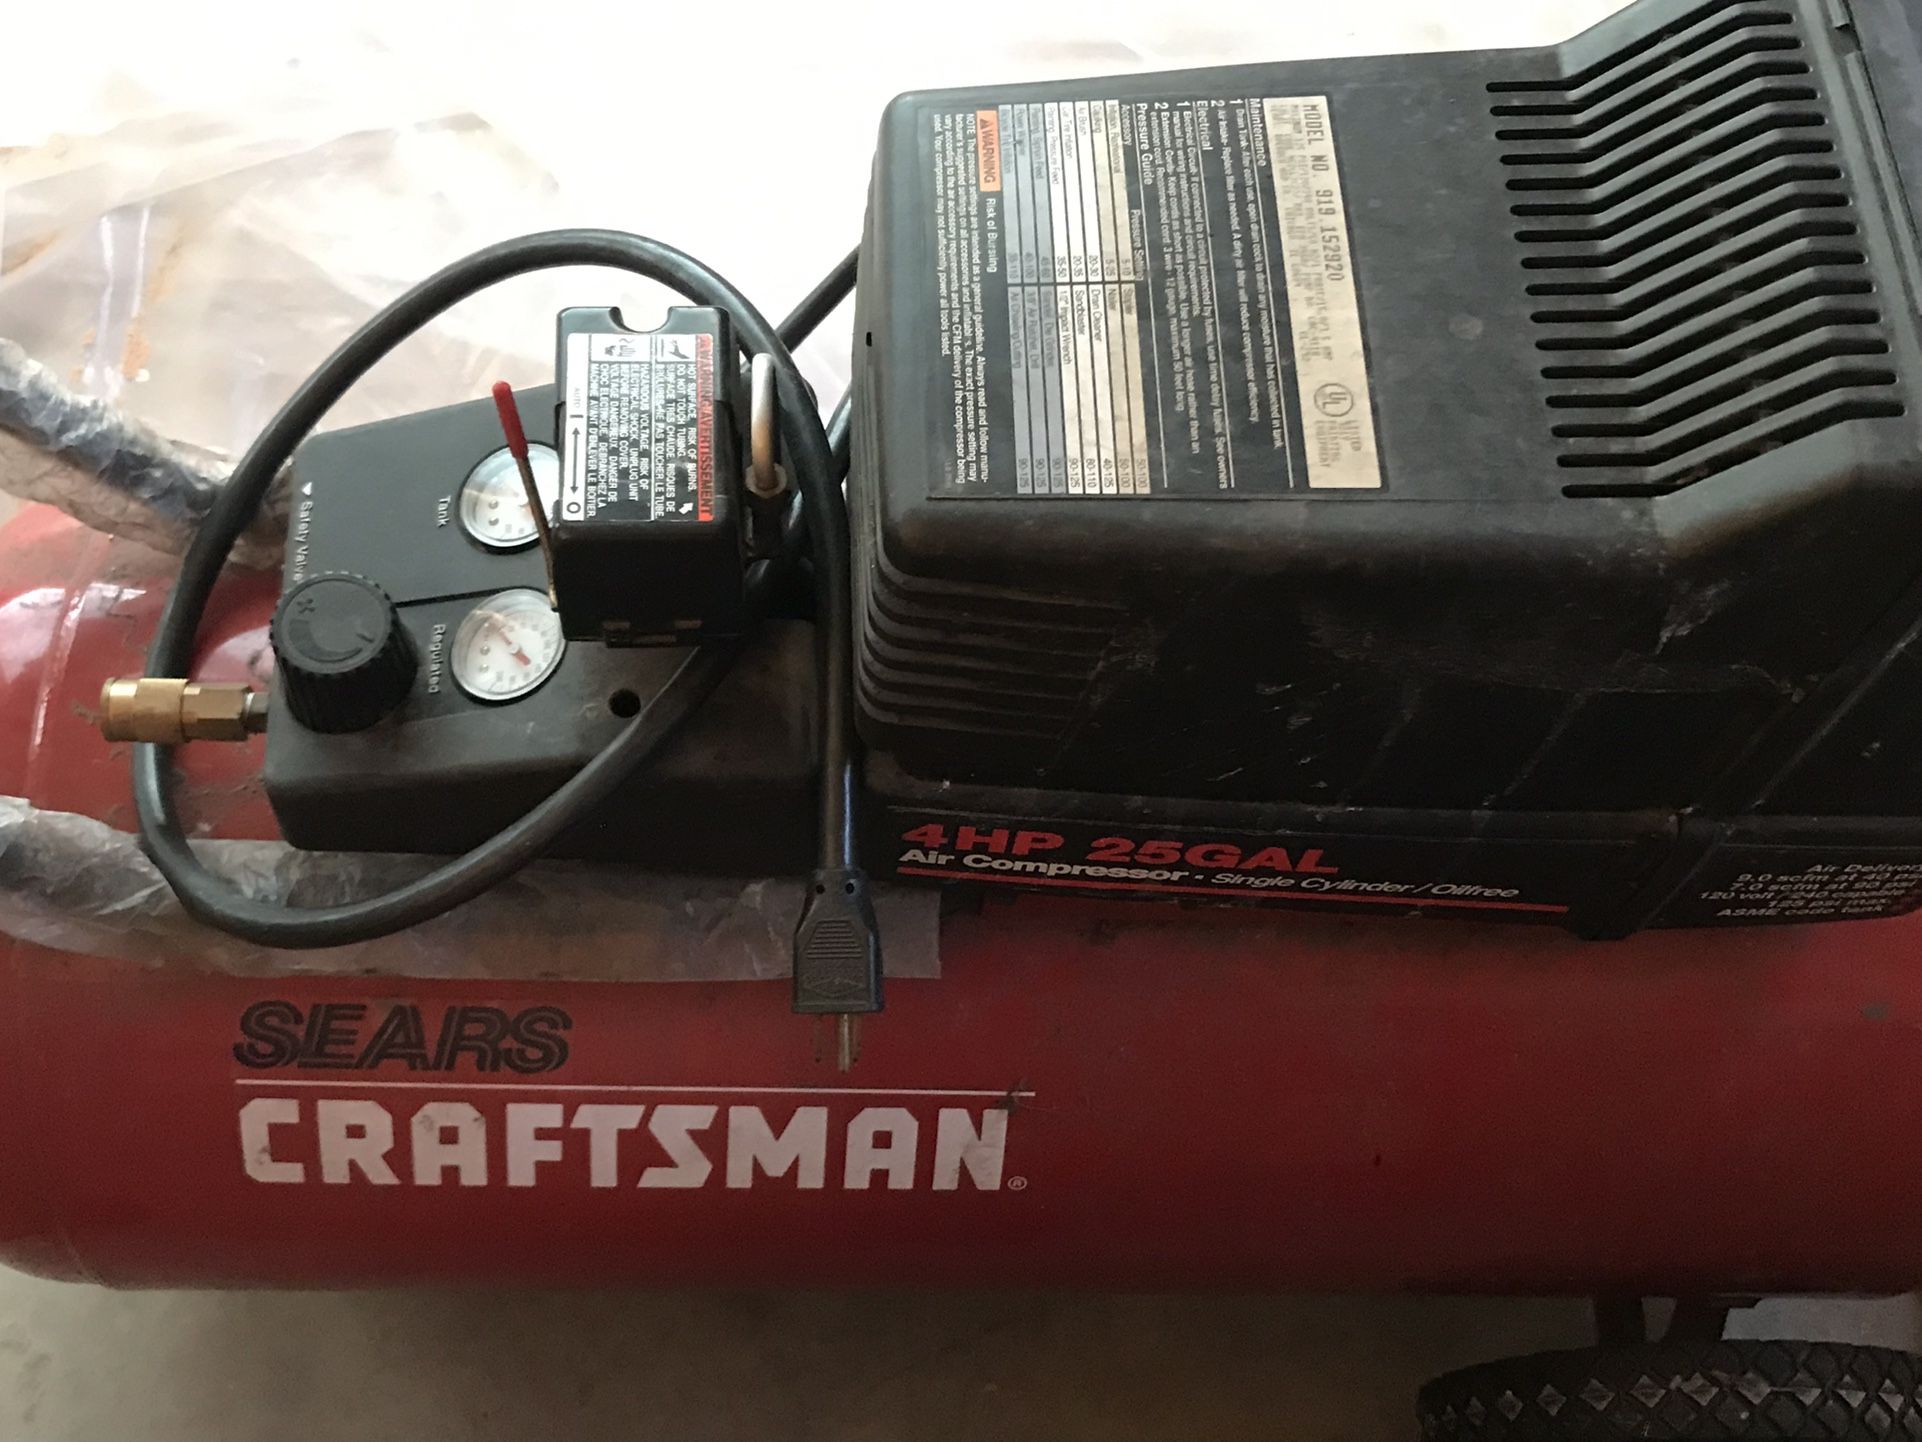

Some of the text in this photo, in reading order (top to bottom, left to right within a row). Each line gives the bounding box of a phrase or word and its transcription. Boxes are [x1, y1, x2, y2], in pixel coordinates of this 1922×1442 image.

[1118, 104, 1133, 145] Accessory
[1196, 100, 1213, 150] Electrical
[1249, 98, 1267, 166] Maintenance
[934, 134, 943, 151] Your
[965, 139, 975, 151] The
[980, 129, 996, 183] WARNING
[1135, 102, 1155, 185] Pressure Guide
[932, 152, 943, 195] compressor
[952, 147, 965, 185] suggested
[964, 152, 975, 184] pressure
[934, 197, 943, 213] may
[954, 186, 967, 215] settings
[965, 185, 978, 215] settings
[1178, 173, 1192, 233] instructions and
[1302, 103, 1325, 144] MODEL
[1314, 189, 1345, 281] 919.152920
[937, 215, 946, 228] not
[957, 217, 965, 227] on
[958, 228, 968, 238] all
[969, 217, 977, 228] are
[984, 197, 1000, 272] Risk of Bursting
[935, 229, 947, 270] sufficiently
[970, 230, 980, 263] intended
[1129, 209, 1146, 281] Pressure Setting
[958, 239, 970, 285] accessories
[971, 265, 979, 274] as
[937, 272, 947, 296] power
[941, 113, 968, 483] vary according to the air accessory requirements and the CFM delivery of the compressor being
[960, 287, 970, 302] and
[970, 282, 983, 312] general
[940, 298, 949, 307] all
[1073, 289, 1086, 335] Sandblaster
[940, 309, 950, 330] tools
[1172, 231, 1199, 453] short Use hose than an
[676, 363, 685, 375] DO
[686, 363, 695, 378] HOT
[963, 350, 973, 365] The
[973, 355, 986, 386] Always
[587, 363, 598, 396] MACHINE
[598, 363, 608, 384] CHOC
[608, 363, 617, 398] VOLTAGE
[629, 363, 638, 409] ELECTRICAL
[639, 363, 648, 410] HAZARDOUS
[665, 363, 674, 399] SURFACE
[676, 378, 685, 393] NOT
[963, 367, 974, 390] exact
[676, 398, 685, 424] TOUCH
[962, 391, 974, 429] pressure
[977, 388, 987, 406] read
[587, 399, 597, 425] AVANT
[619, 363, 628, 469] BEFORE REMOVING COVER.
[978, 408, 988, 425] and
[654, 422, 664, 438] PAS
[687, 427, 696, 445] RISK
[978, 426, 989, 453] follow
[587, 427, 597, 469] D'ENLEVER
[654, 441, 664, 479] TOUCHER
[687, 448, 696, 459] OF
[964, 431, 977, 460] setting
[587, 472, 597, 482] LE
[597, 442, 607, 494] DEBRANCHEZ
[608, 455, 617, 488] DANGER
[629, 447, 638, 479] UNPLUG
[639, 457, 648, 475] RISK
[965, 462, 976, 481] may
[1214, 436, 1227, 489] See owners
[629, 483, 638, 501] UNIT
[639, 478, 648, 490] OF
[655, 482, 664, 492] LE
[665, 463, 675, 498] RISQUES
[597, 497, 607, 507] LA
[608, 491, 617, 501] DE
[655, 495, 664, 518] TUBE.
[666, 501, 675, 512] DE
[297, 501, 314, 541] Safety
[438, 495, 451, 528] Tank
[428, 624, 446, 694] Regulated
[901, 823, 1339, 874] 4HP 25GAL
[899, 848, 1520, 898] Air Compressor Single Cylinder Oilfree
[1737, 873, 1773, 882] 9.0
[1776, 872, 1829, 881] scfm
[1835, 873, 1858, 881] at
[1807, 864, 1837, 873] Air
[1700, 890, 1736, 899] 120
[1739, 891, 1775, 899] volt
[1730, 882, 1764, 891] 7.0
[1767, 882, 1820, 891] scfm
[1825, 882, 1849, 890] at
[1716, 907, 1780, 916] ASME
[234, 1001, 572, 1072] SEARS
[238, 1097, 1009, 1190] CRAFTSMAN
